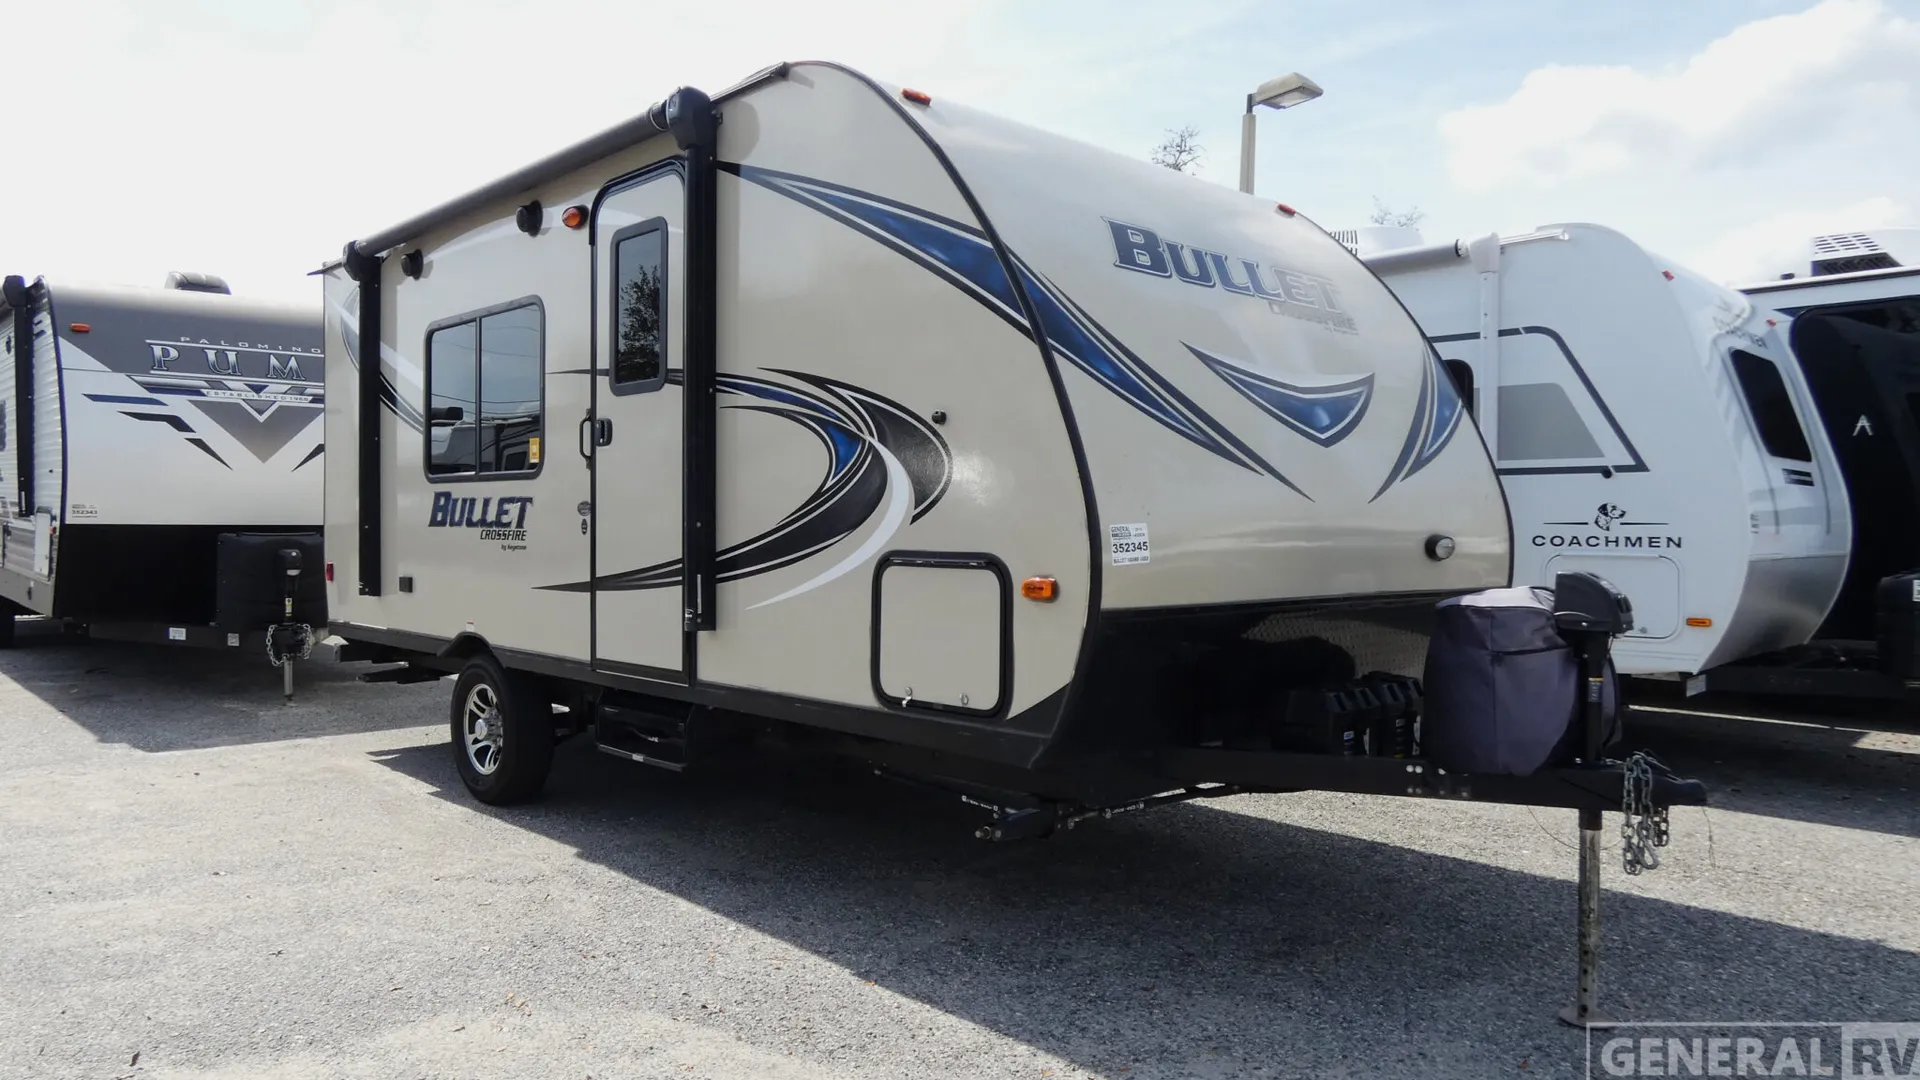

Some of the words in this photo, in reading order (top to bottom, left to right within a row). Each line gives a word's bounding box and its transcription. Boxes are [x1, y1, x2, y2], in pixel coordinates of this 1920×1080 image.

[1101, 216, 1343, 314] BULLET
[180, 336, 321, 353] PALOMINO
[149, 343, 307, 381] PUM
[205, 390, 287, 401] ESTABLISHED
[428, 491, 534, 529] BULLET
[480, 529, 527, 541] CROSSFIRE
[1532, 535, 1682, 548] COACHMEN
[1112, 541, 1149, 553] 352345
